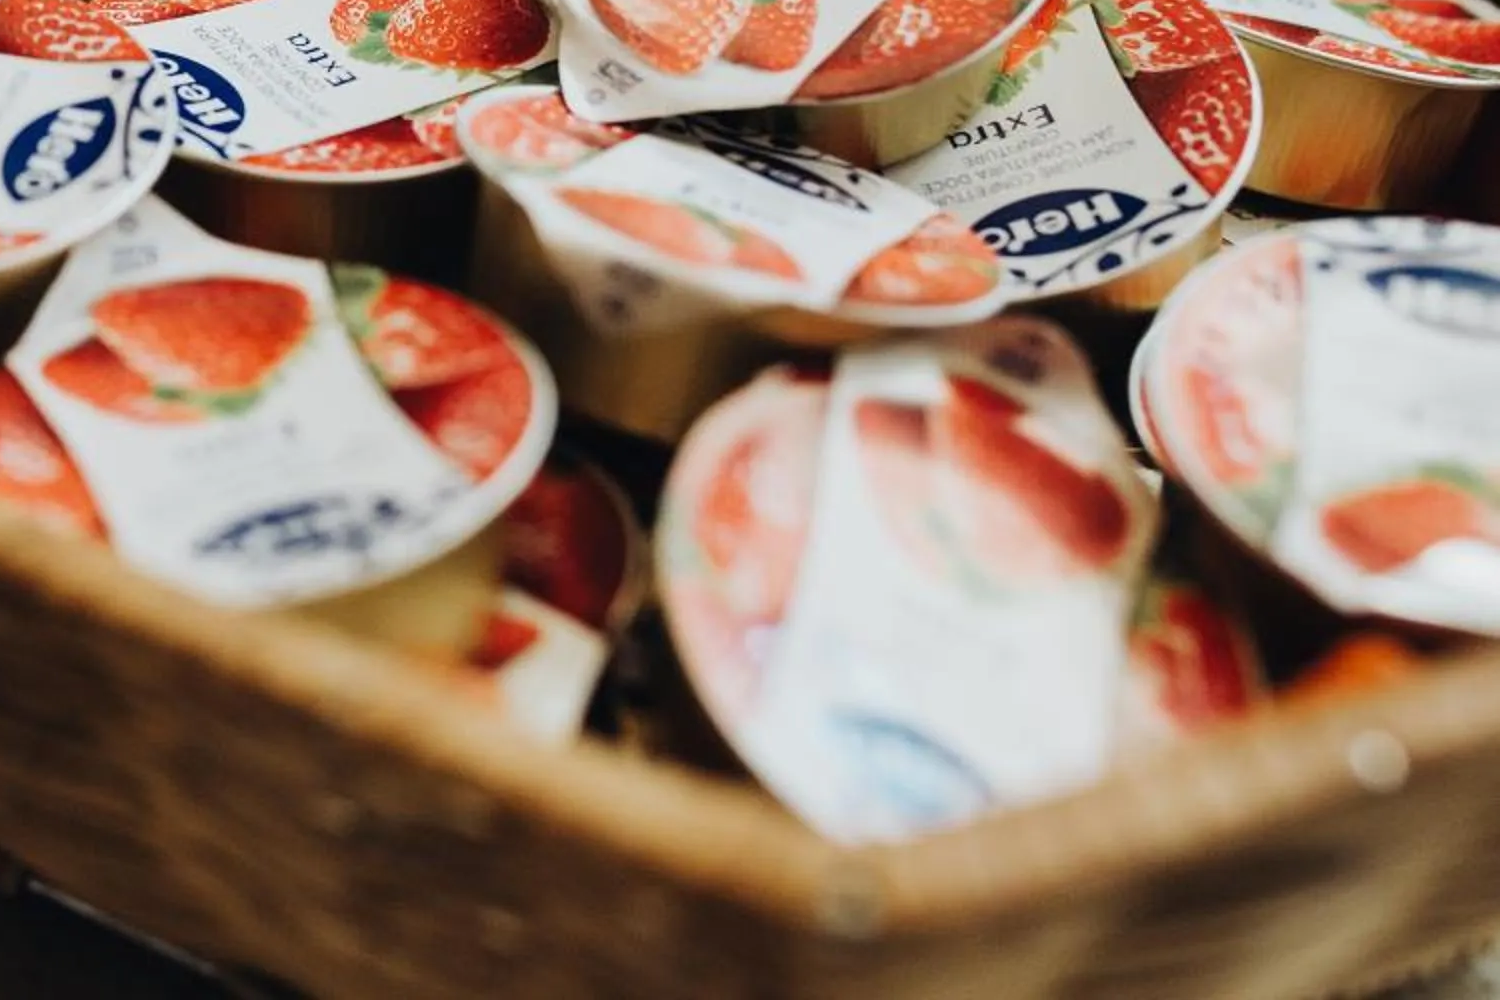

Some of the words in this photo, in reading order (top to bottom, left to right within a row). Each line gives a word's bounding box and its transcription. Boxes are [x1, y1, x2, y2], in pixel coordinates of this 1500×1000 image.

[153, 56, 241, 127] Hero
[286, 33, 357, 87] Extra
[13, 106, 105, 199] Hero
[944, 103, 1056, 149] Extra
[978, 191, 1123, 254] Hero
